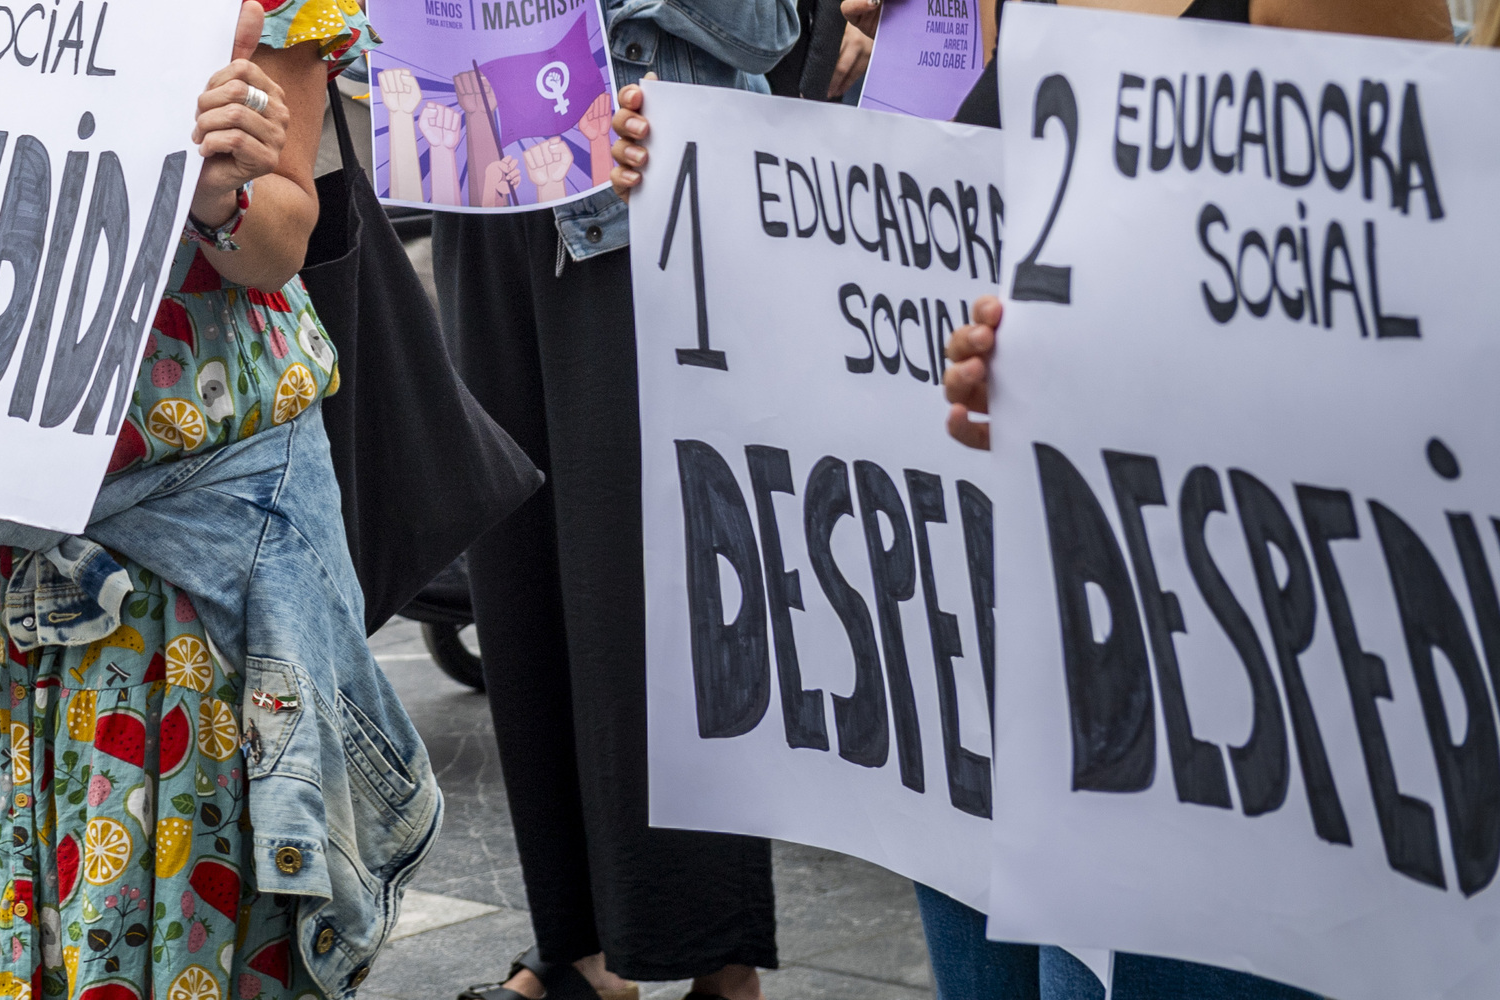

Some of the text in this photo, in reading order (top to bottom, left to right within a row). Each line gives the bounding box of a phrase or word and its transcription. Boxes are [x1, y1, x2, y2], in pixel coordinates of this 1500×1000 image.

[425, 0, 463, 19] MENOS
[426, 17, 463, 30] PARA ATENDER
[926, 20, 969, 36] FAMILIA BAT
[943, 38, 968, 51] ARRETA
[917, 50, 967, 70] JASO GABE
[1010, 68, 1445, 306] 2 EDUCADORA
[658, 141, 729, 372] 1
